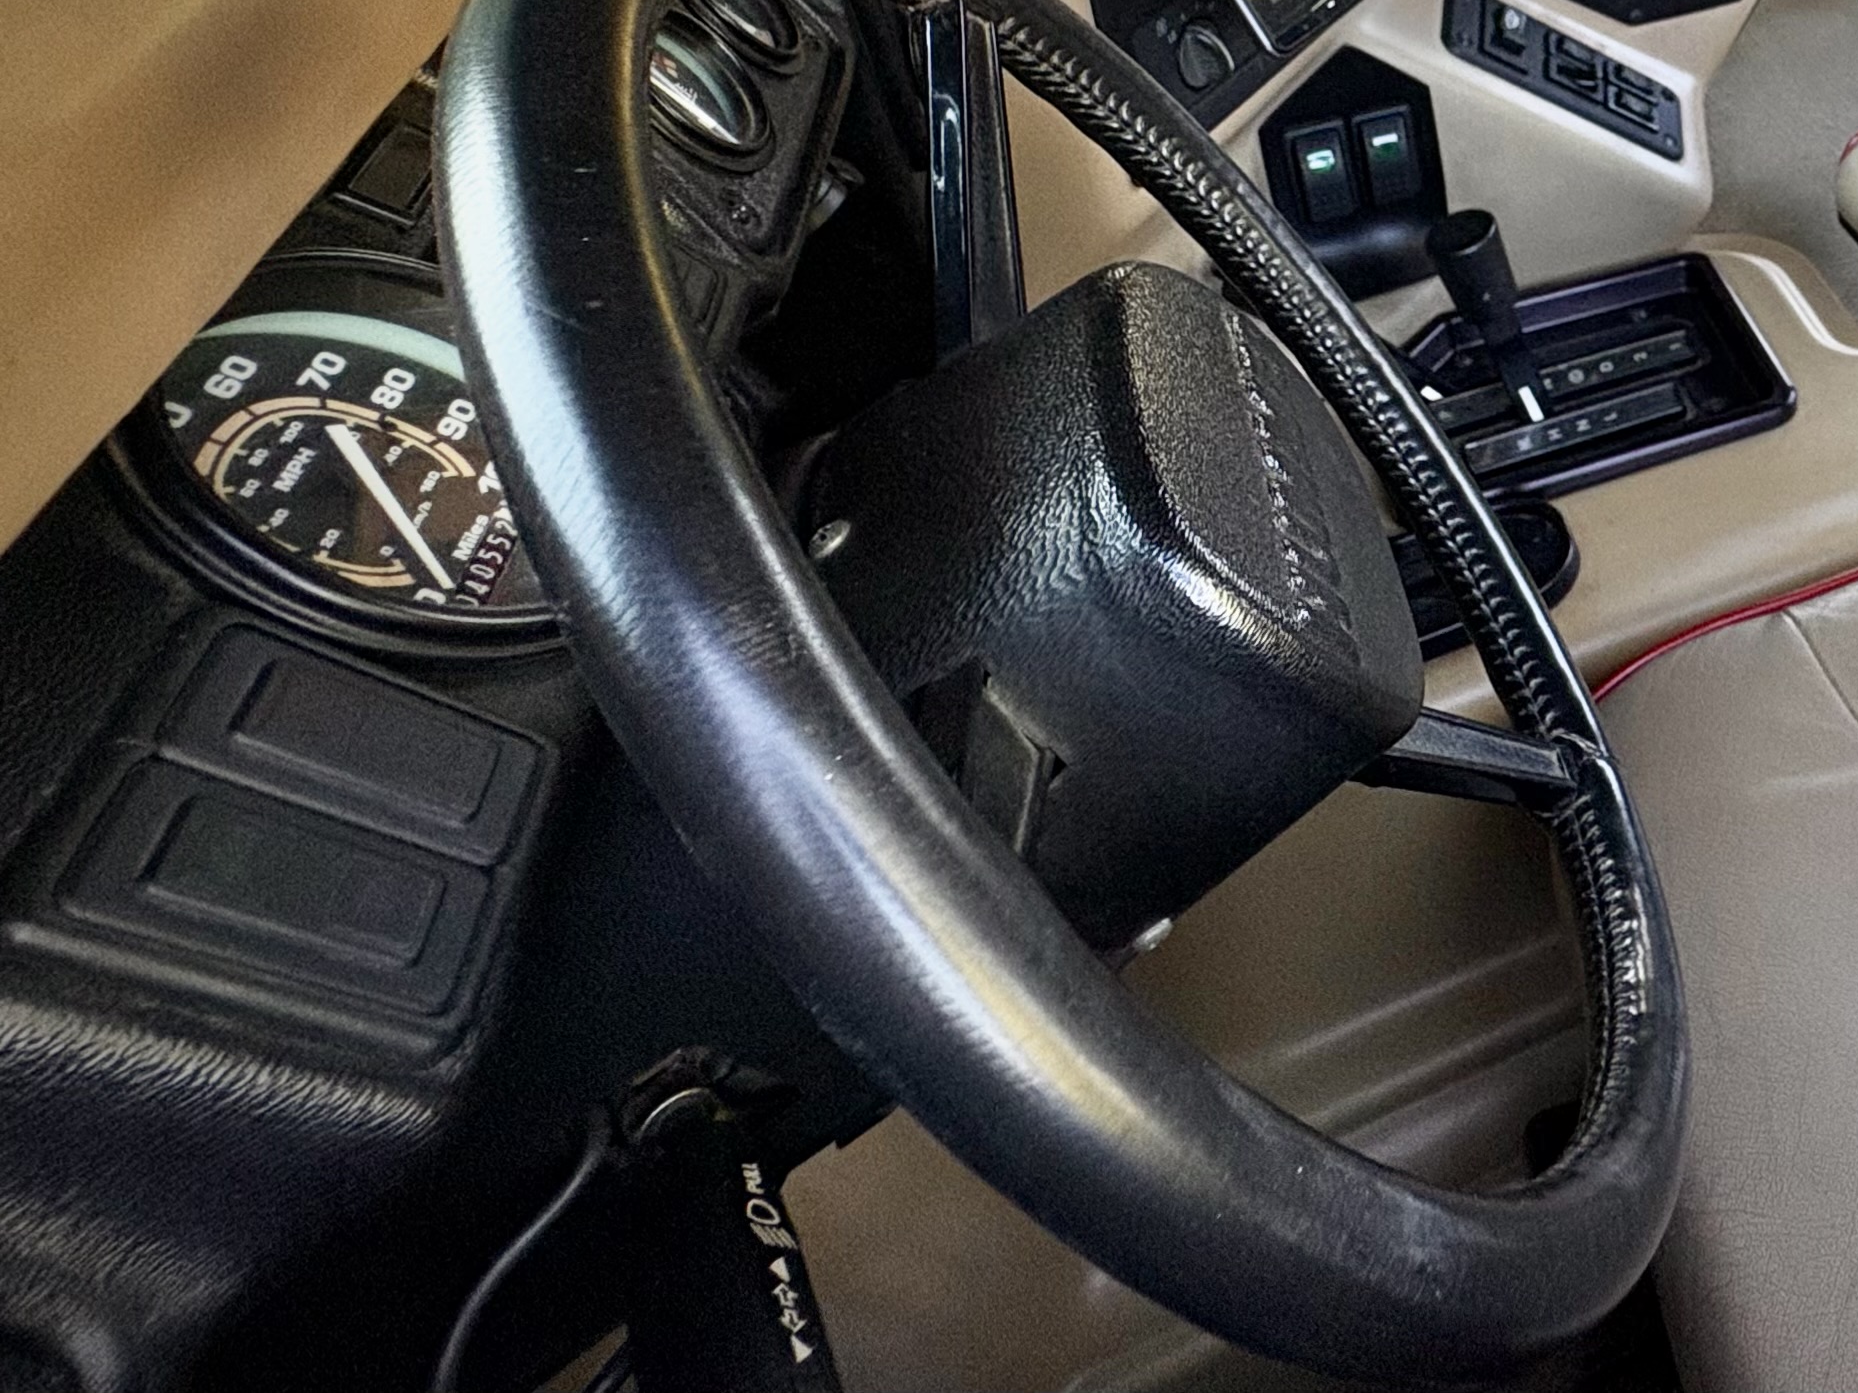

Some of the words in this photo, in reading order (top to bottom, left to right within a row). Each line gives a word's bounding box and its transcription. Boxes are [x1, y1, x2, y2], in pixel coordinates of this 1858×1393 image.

[203, 355, 258, 399] 60
[295, 351, 347, 391] 70
[370, 368, 416, 410] 80
[279, 420, 304, 445] 100
[437, 398, 476, 441] 90
[272, 446, 317, 493] MPH
[412, 500, 433, 530] m/h
[450, 514, 489, 561] Miles
